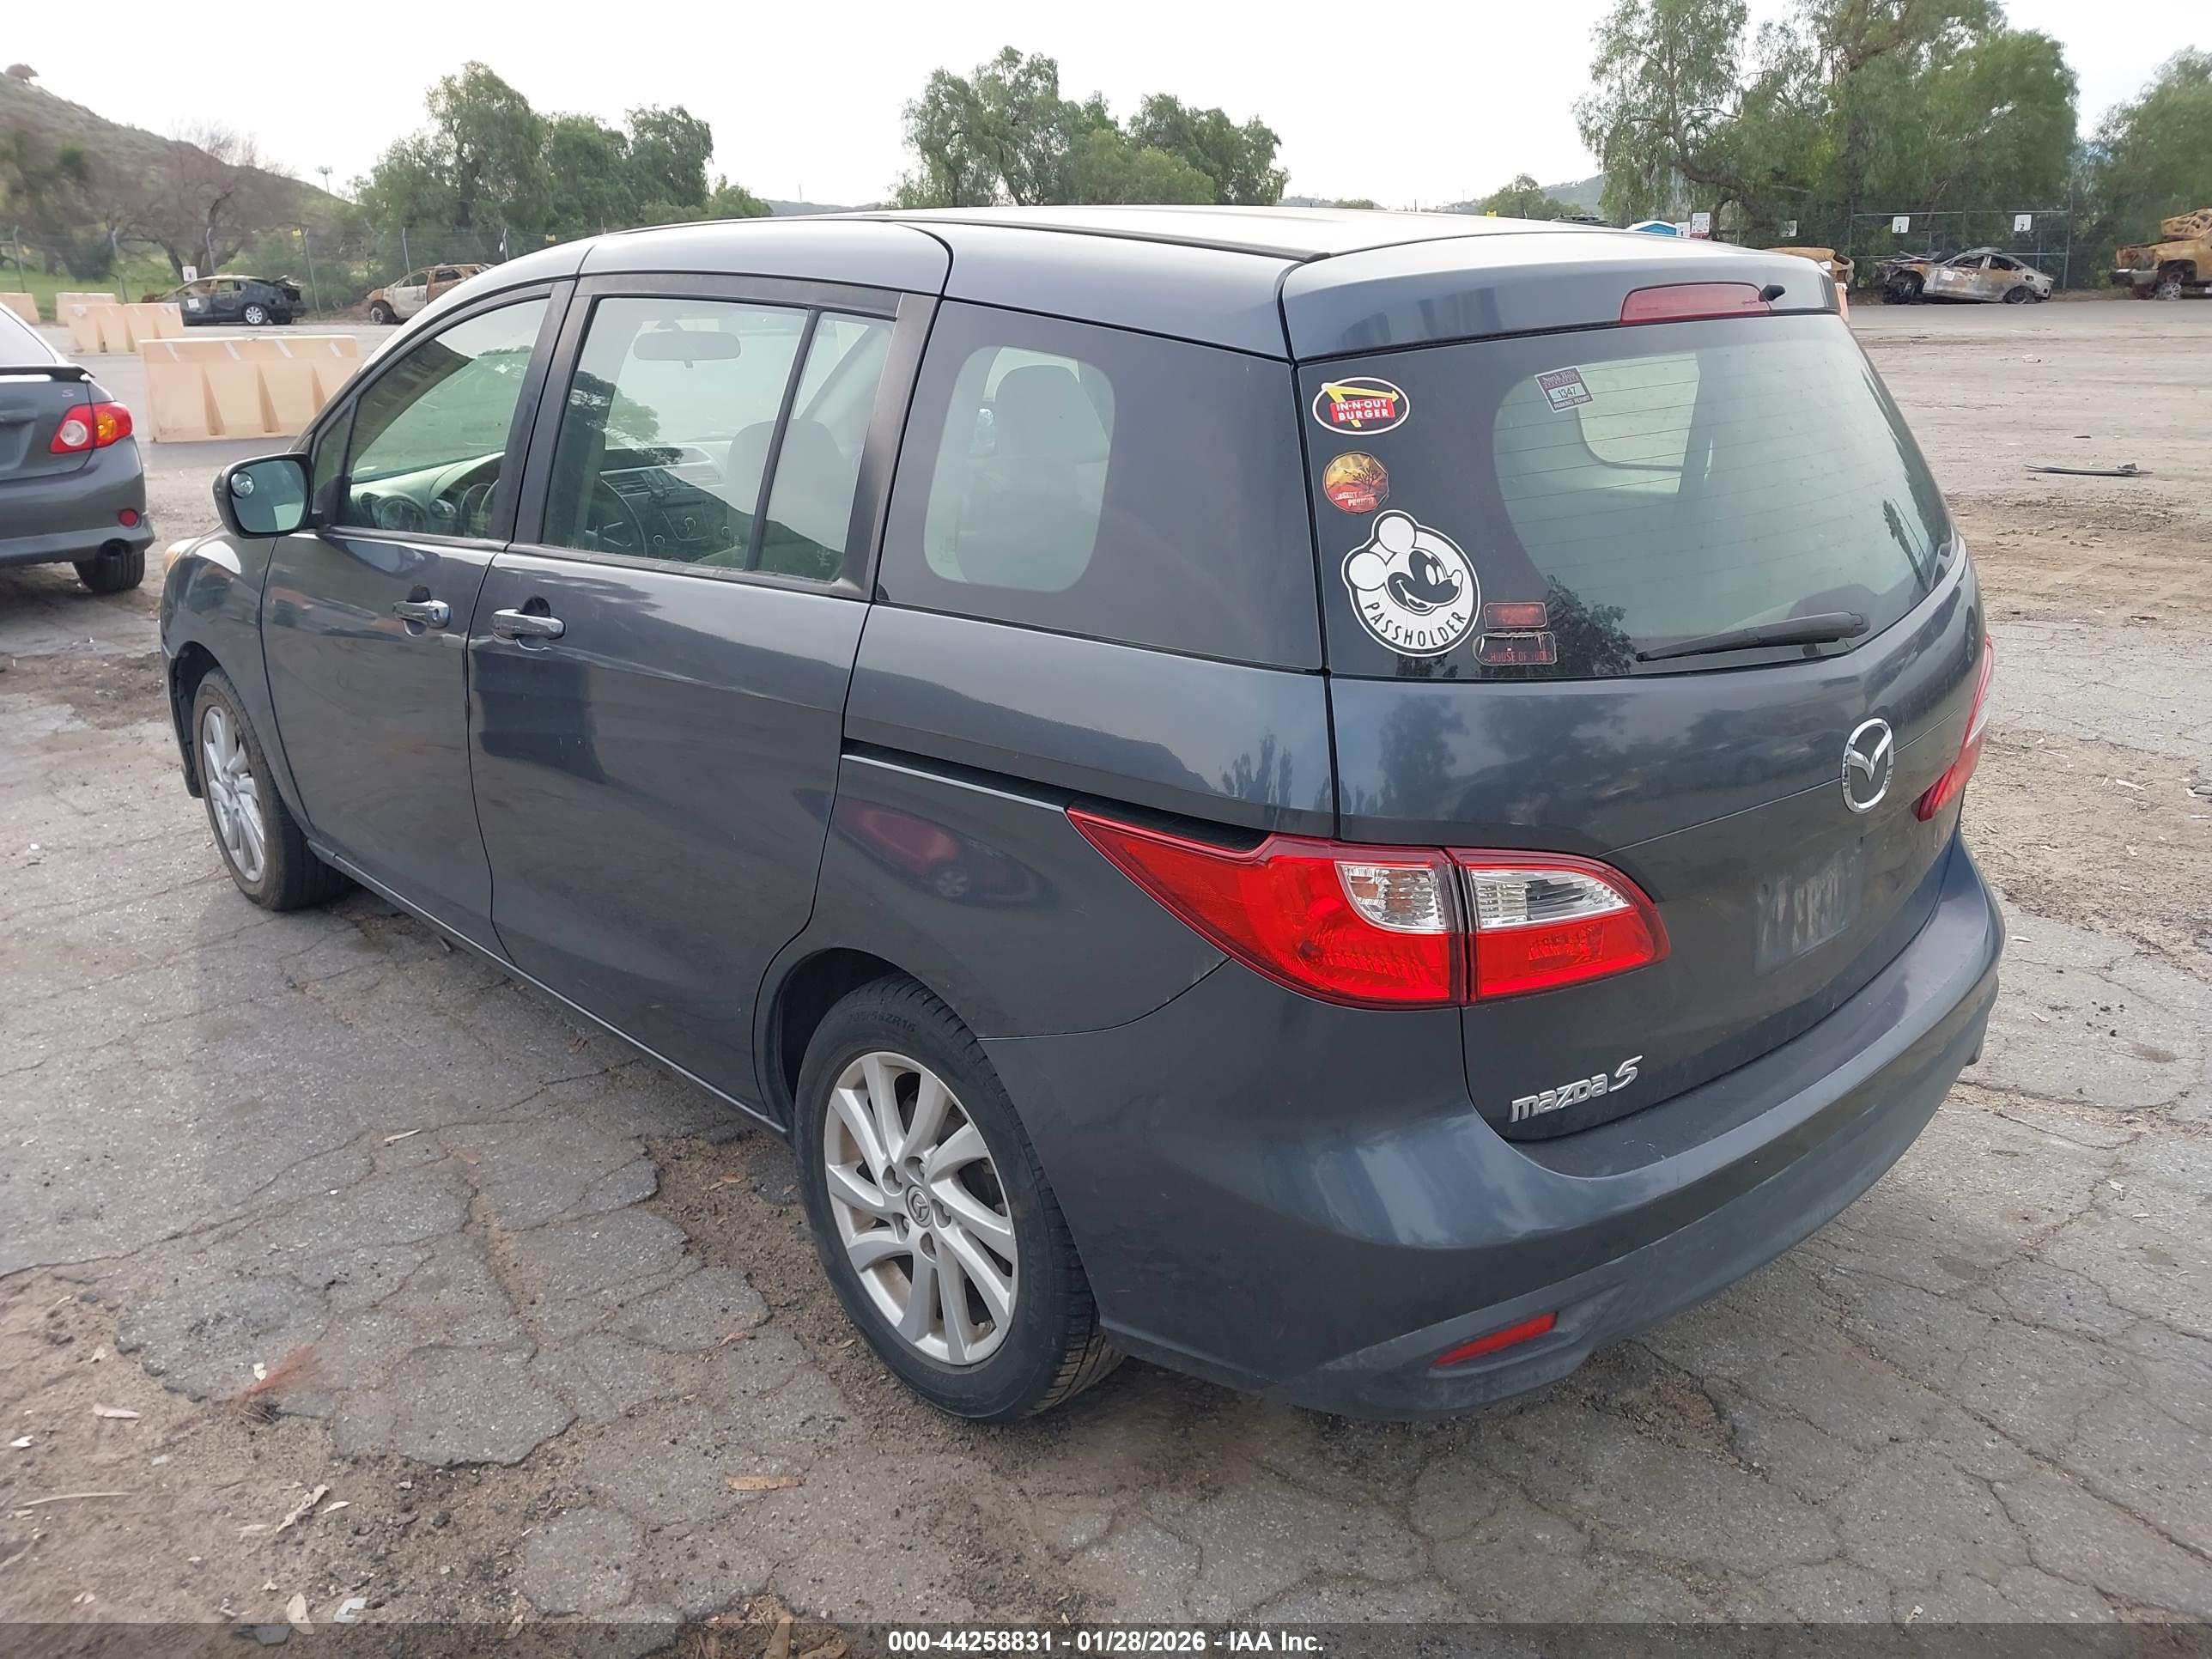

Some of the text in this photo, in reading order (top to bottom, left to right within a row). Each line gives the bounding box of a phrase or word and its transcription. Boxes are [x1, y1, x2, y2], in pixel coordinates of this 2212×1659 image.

[61, 389, 74, 398] S
[1558, 386, 1577, 398] 1347
[1338, 408, 1389, 421] BURGER
[1364, 601, 1468, 647] PASSHOLDER
[1491, 651, 1516, 662] HOUSE
[1518, 651, 1527, 661] OF
